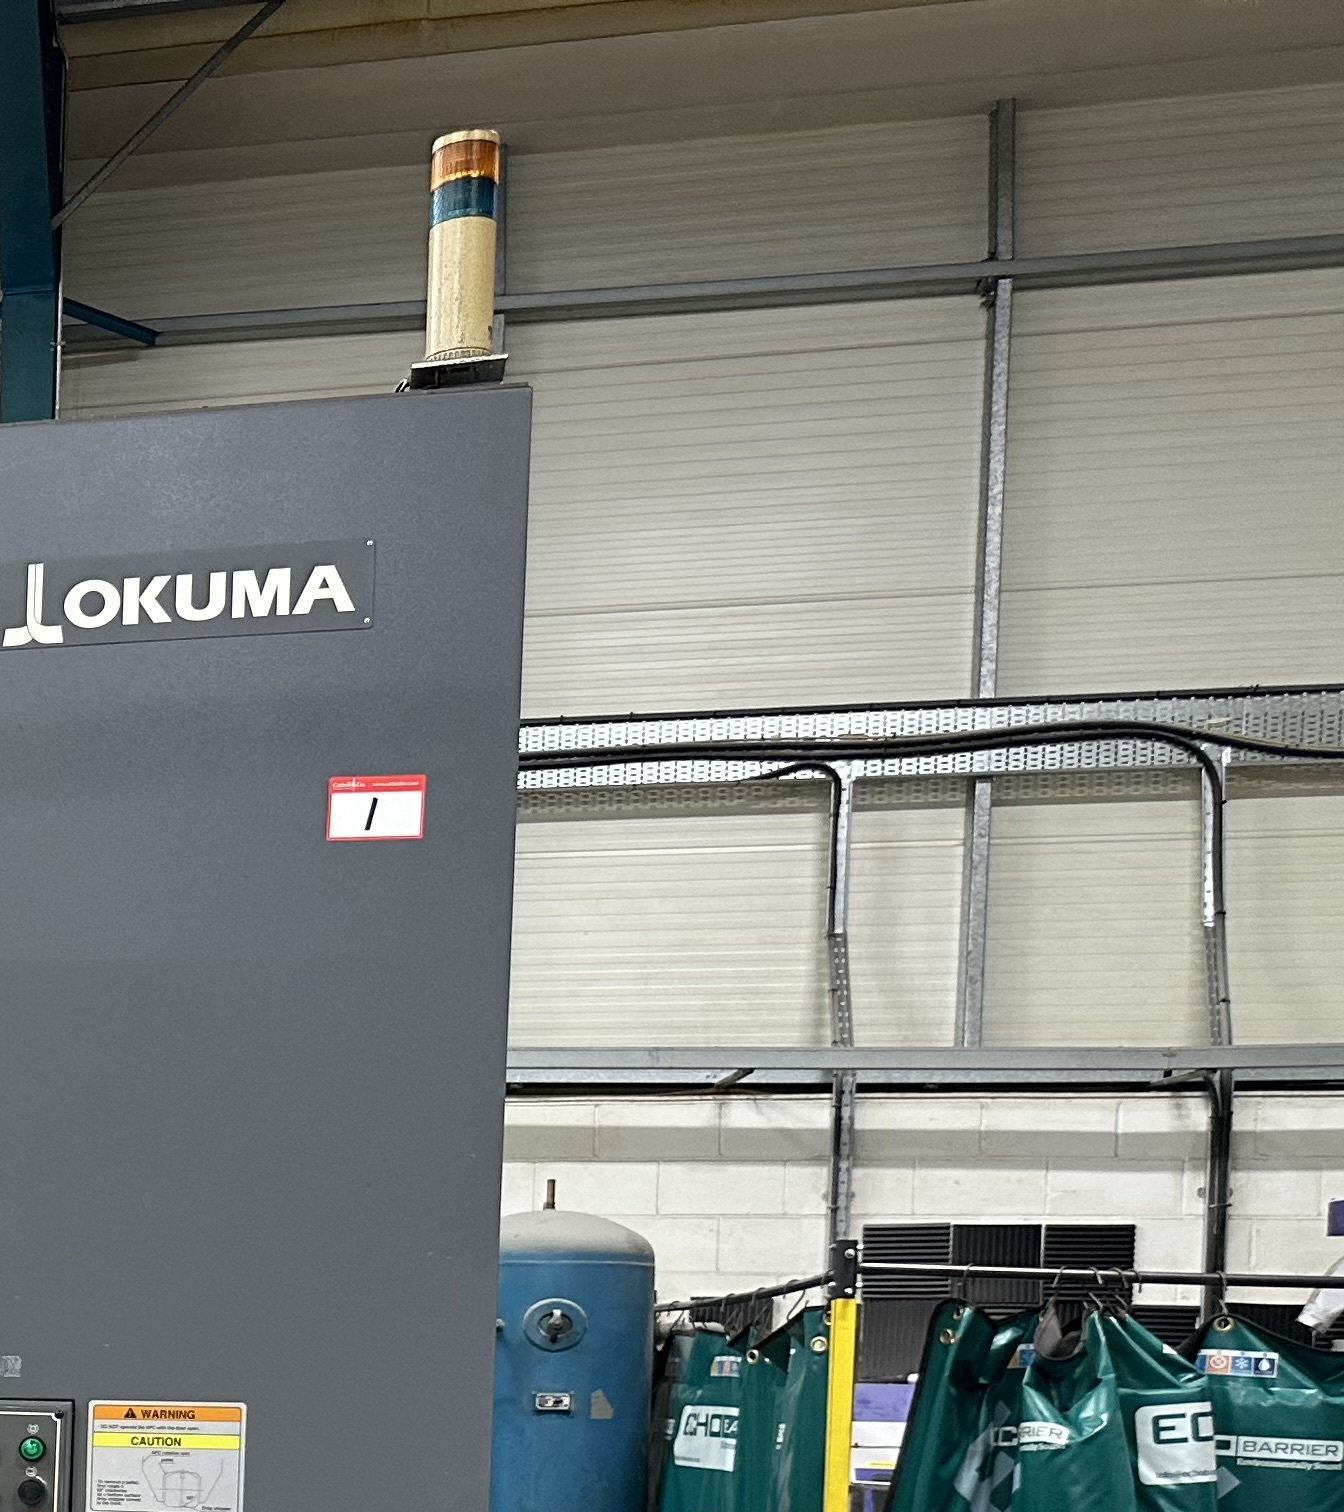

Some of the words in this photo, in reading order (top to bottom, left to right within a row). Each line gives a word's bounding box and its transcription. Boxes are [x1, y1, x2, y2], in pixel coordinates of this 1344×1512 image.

[62, 563, 356, 629] OKUMA
[141, 1409, 196, 1420] WARNING
[130, 1436, 182, 1446] CAUTION
[1242, 1440, 1339, 1457] BARRIER
